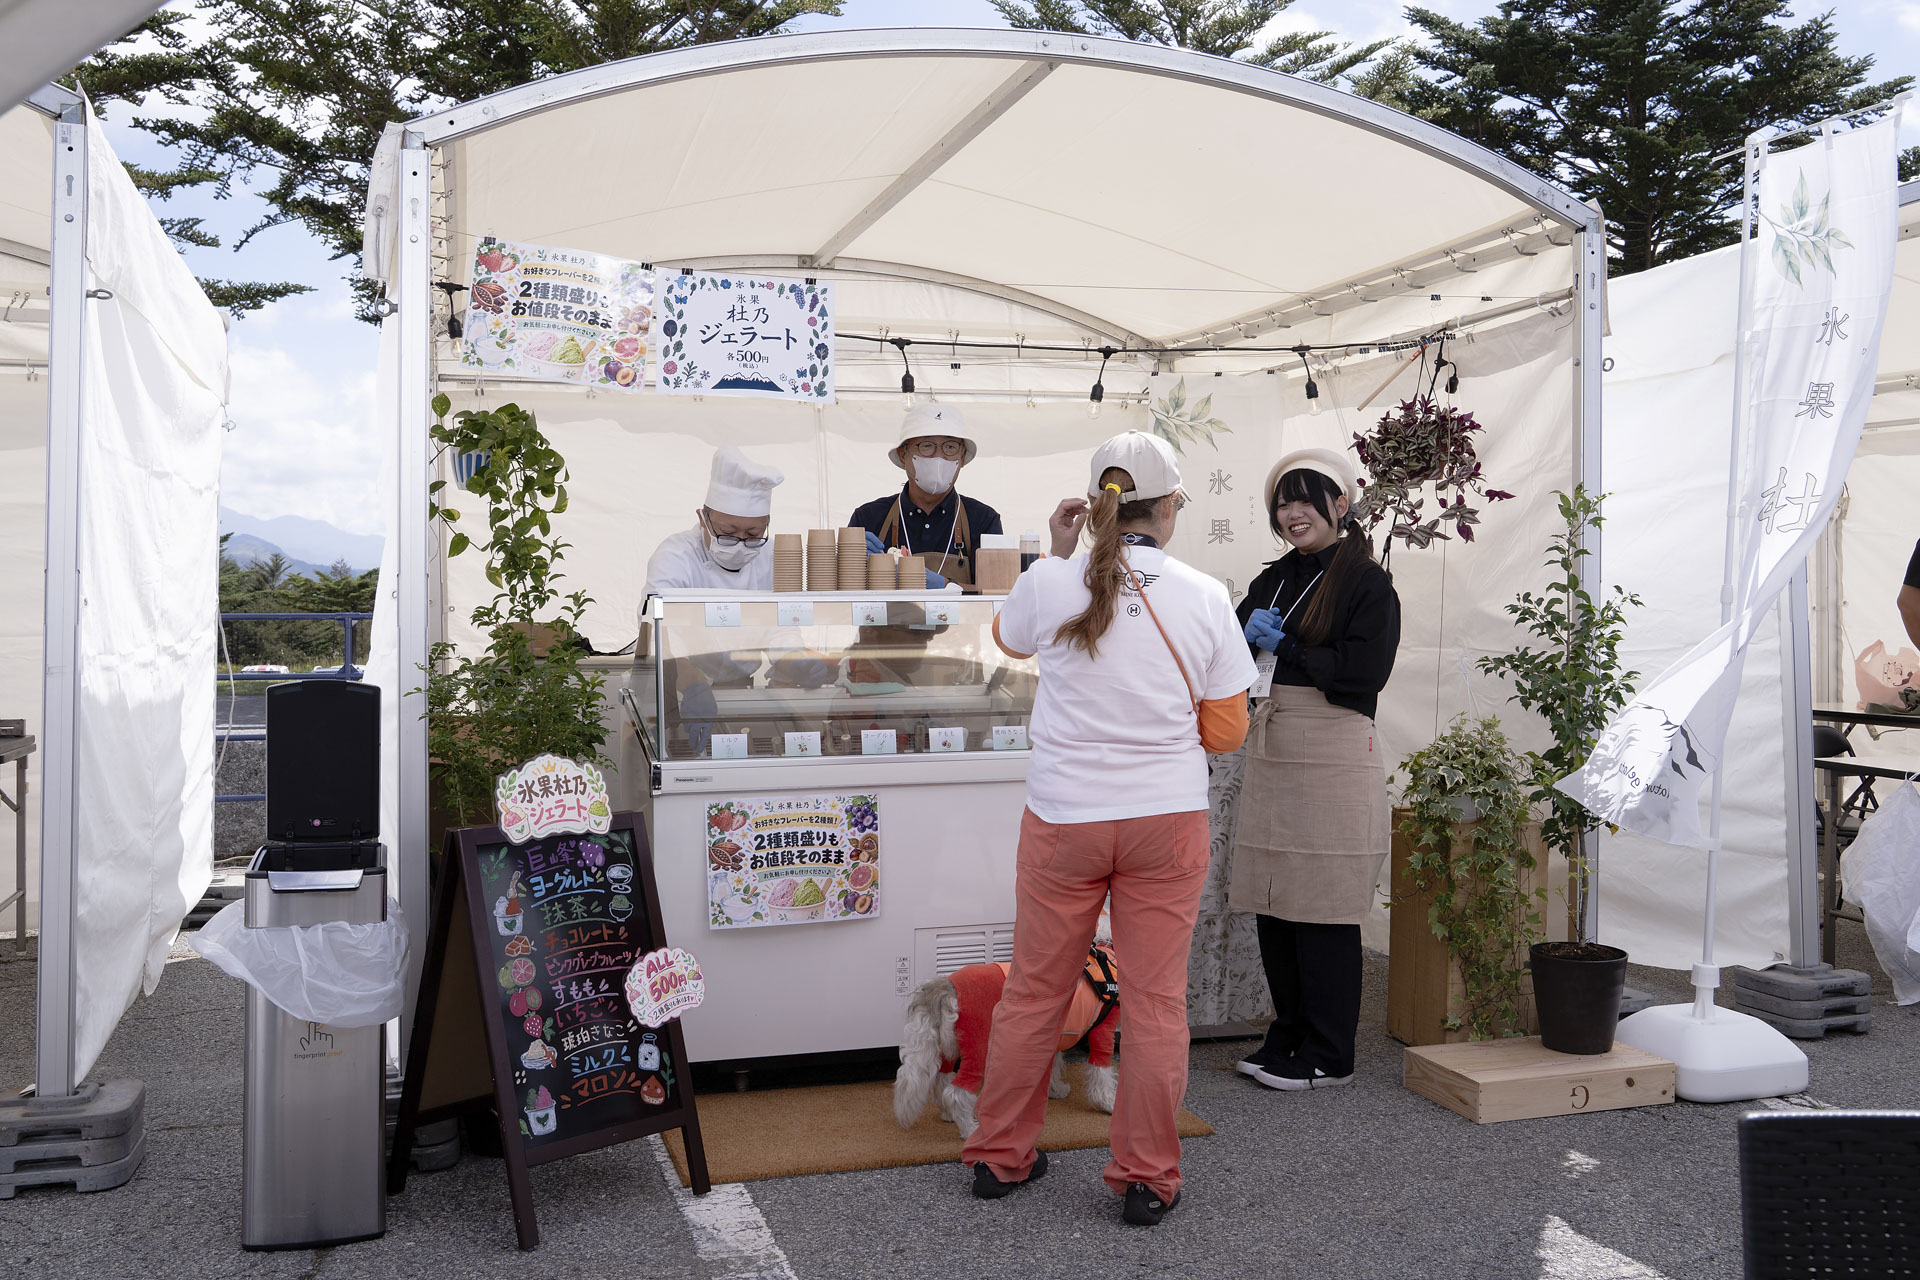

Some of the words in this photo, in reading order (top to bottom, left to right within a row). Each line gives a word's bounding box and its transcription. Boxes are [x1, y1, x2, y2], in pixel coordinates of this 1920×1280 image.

[736, 293, 760, 305] 氷果
[511, 299, 613, 329] お値段そのまま
[726, 304, 769, 324] 杜乃
[699, 322, 798, 351] ジェラート
[727, 350, 769, 364] 各500円
[518, 774, 588, 804] 氷果杜乃
[529, 798, 588, 826] ジェラート
[754, 830, 839, 851] 2種類盛りも
[525, 841, 576, 872] 巨峰
[750, 848, 845, 870] お値段そのまま
[529, 868, 595, 898] ヨーグルト
[540, 895, 588, 926] 抹茶
[544, 922, 614, 953] チョコレート
[545, 951, 632, 977] ピンクグレープフルーツ
[646, 951, 675, 980] ALL
[551, 978, 596, 1005] すもも
[649, 971, 688, 1003] 500円
[555, 996, 606, 1028] いちご
[561, 1023, 625, 1052] 琥珀きなこ
[294, 1051, 326, 1060] fingerprint
[570, 1048, 616, 1074] ミルク
[571, 1069, 627, 1097] マロン
